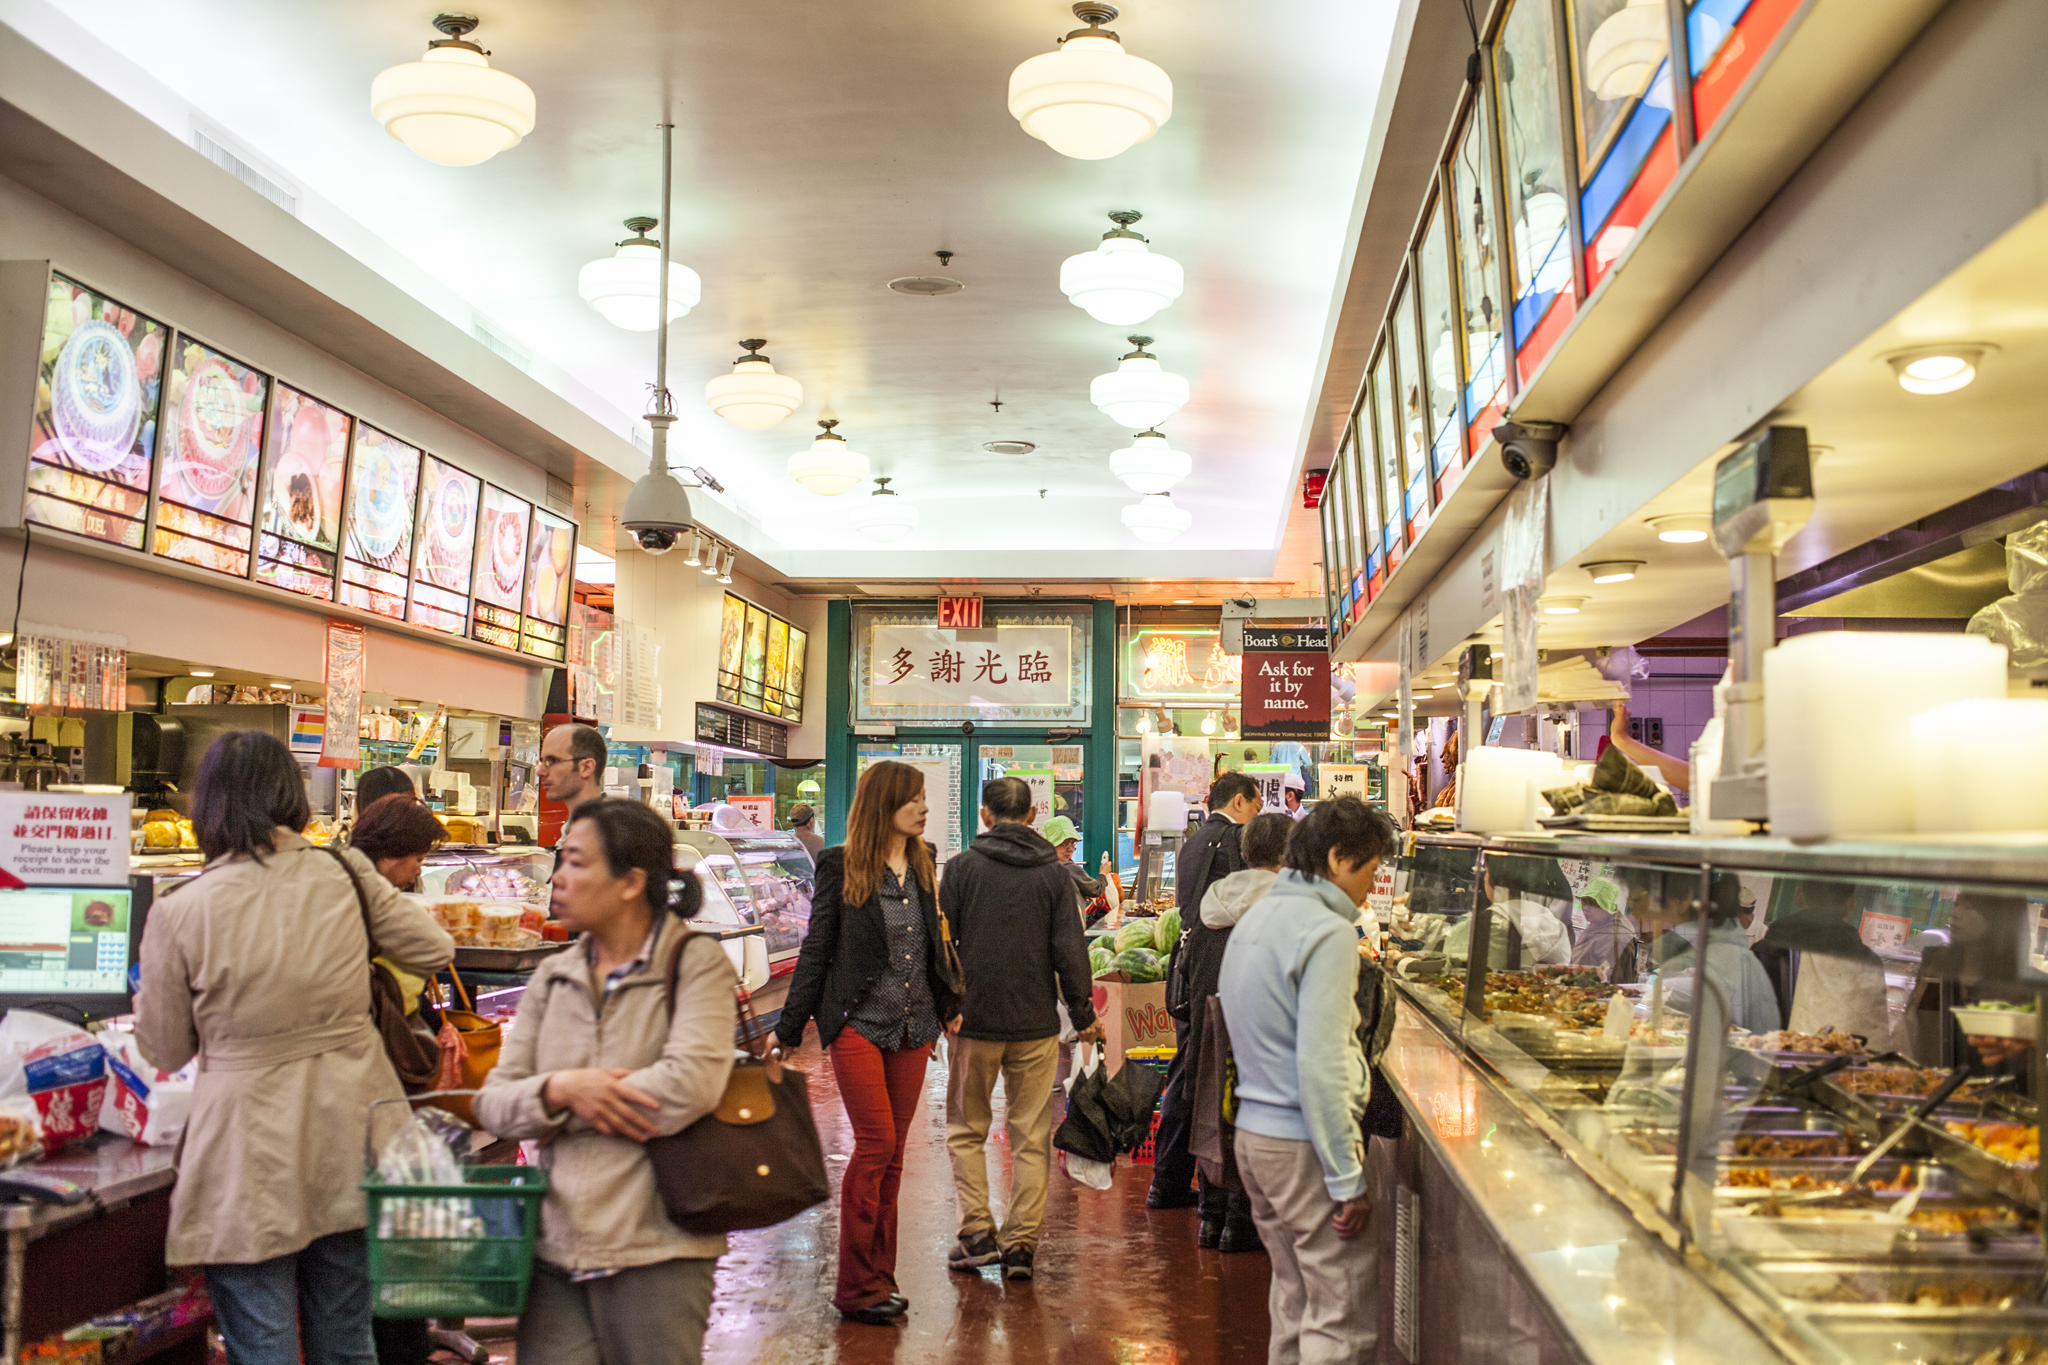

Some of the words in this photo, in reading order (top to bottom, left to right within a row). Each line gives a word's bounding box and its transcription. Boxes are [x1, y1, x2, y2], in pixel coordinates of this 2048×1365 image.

[938, 597, 980, 628] EXIT
[1244, 634, 1278, 647] Boar's
[1297, 634, 1328, 647] Head
[889, 647, 1053, 684] 多謝光臨
[1258, 660, 1289, 676] Ask
[1292, 661, 1314, 676] for
[1270, 677, 1281, 692] it
[1285, 677, 1303, 697] by
[1264, 699, 1308, 709] name.
[24, 806, 107, 821] 請保留收據
[21, 844, 53, 854] Please
[57, 845, 80, 855] keep
[13, 856, 48, 864] receipt
[65, 856, 91, 864] show
[95, 856, 110, 865] the
[19, 865, 65, 874] doorman
[81, 867, 102, 875] exit.
